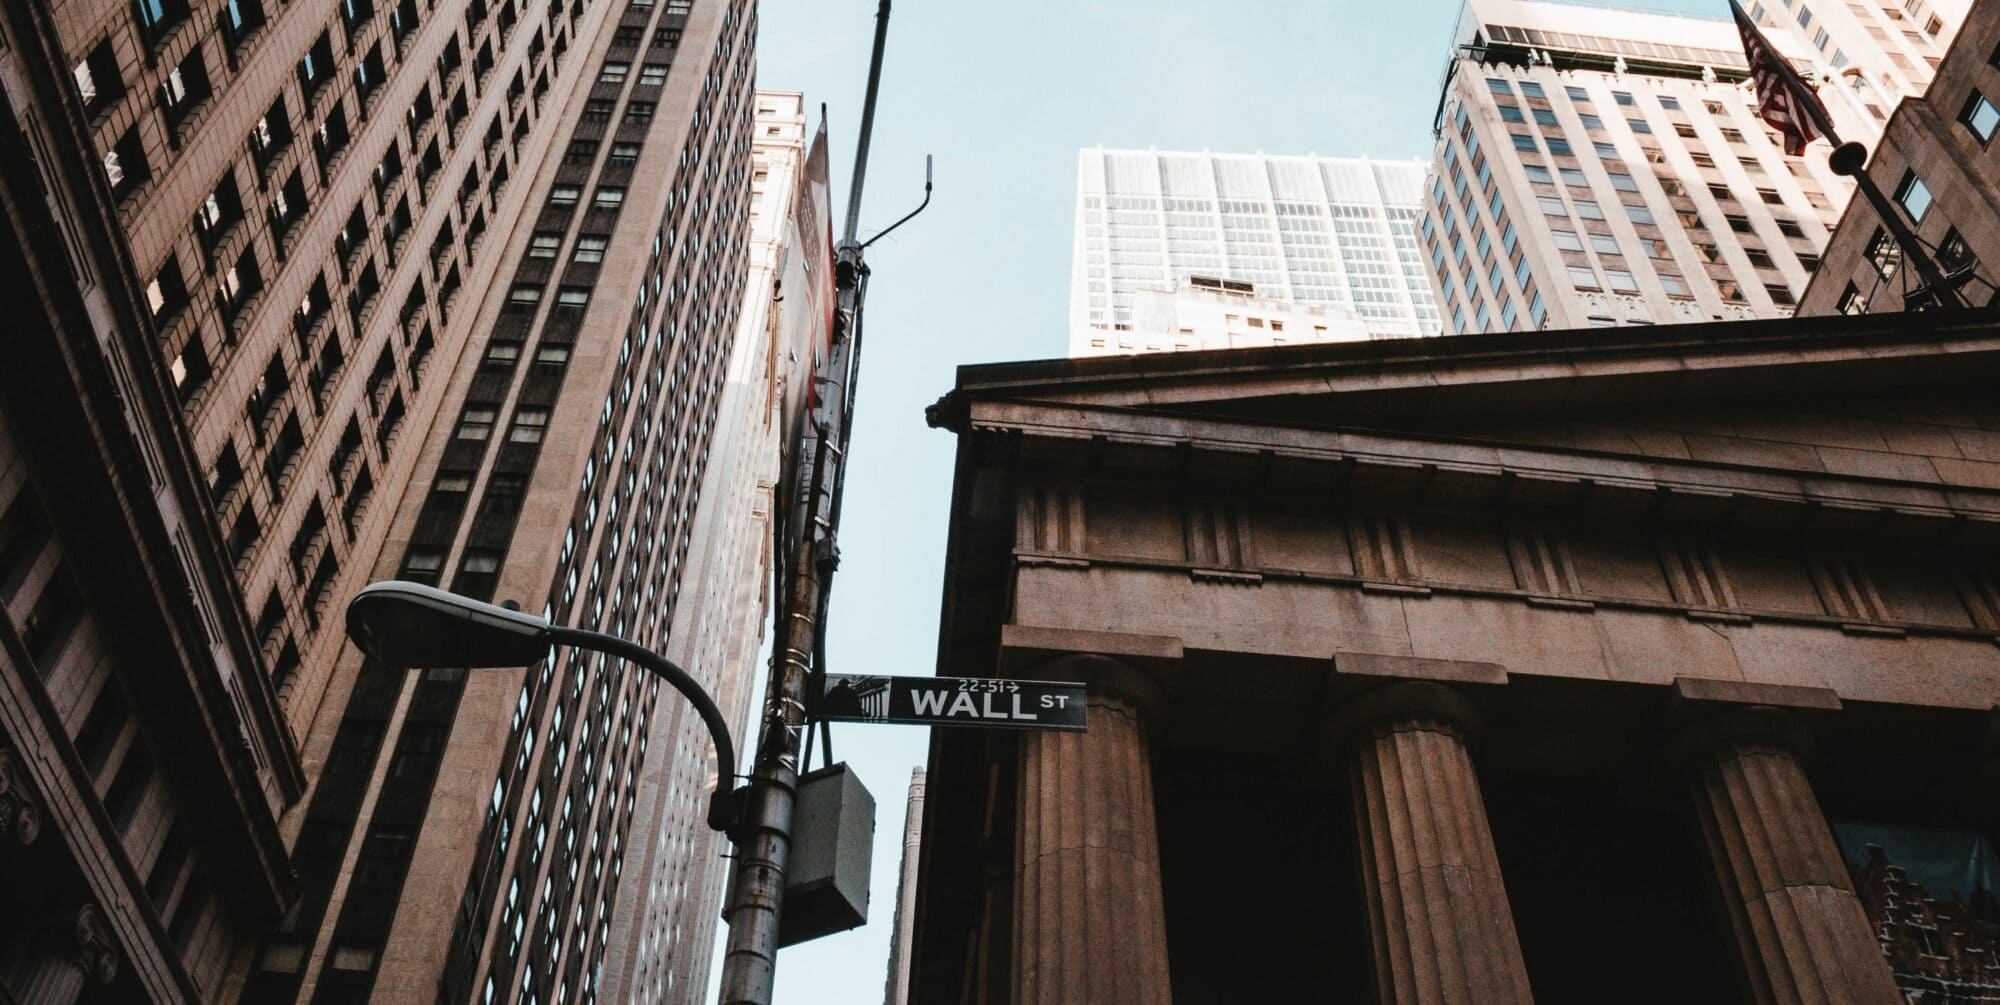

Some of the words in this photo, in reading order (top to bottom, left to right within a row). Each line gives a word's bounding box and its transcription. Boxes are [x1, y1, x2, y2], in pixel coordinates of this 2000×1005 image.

[958, 679, 1004, 693] 22-51
[910, 689, 1037, 720] WALL
[1040, 694, 1069, 709] ST
